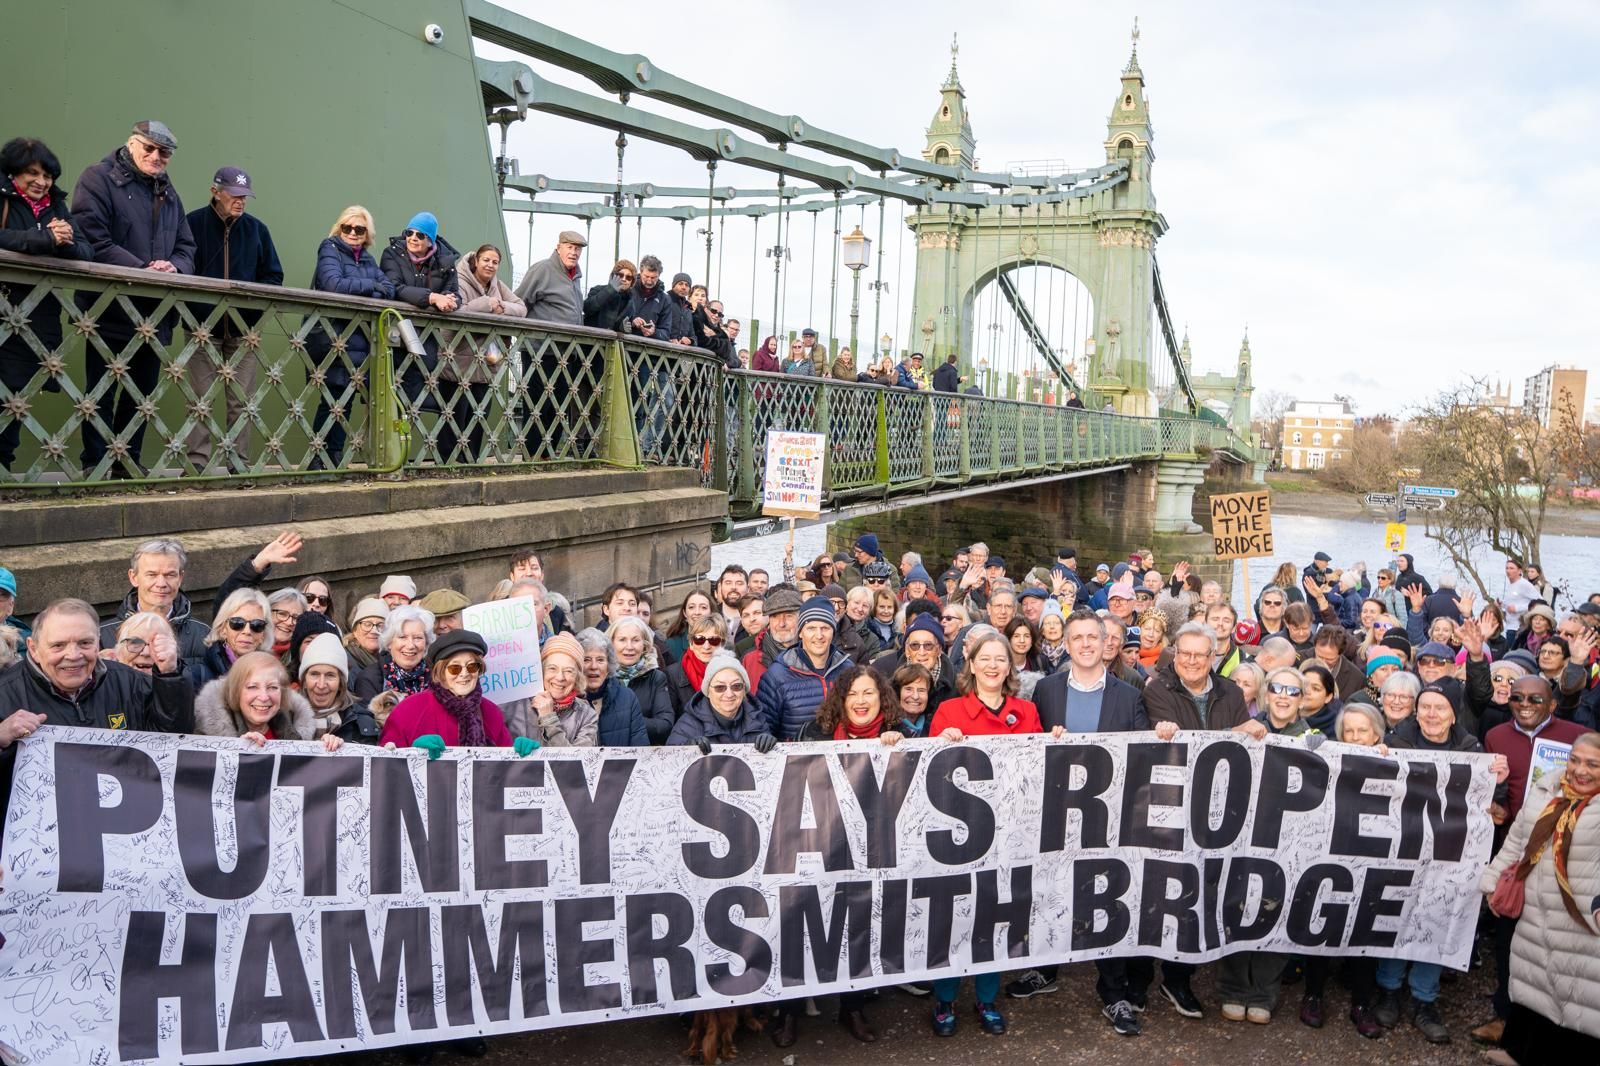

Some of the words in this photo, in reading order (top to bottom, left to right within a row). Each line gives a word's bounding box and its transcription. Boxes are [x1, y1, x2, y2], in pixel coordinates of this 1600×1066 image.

[779, 457, 812, 468] BREXIT
[1213, 496, 1268, 517] MOVE
[1218, 514, 1263, 534] THE
[1214, 533, 1273, 556] BRIDGE
[466, 601, 532, 633] BARNES
[480, 665, 537, 694] BRIDGE
[54, 743, 637, 900] PUTNEY
[681, 746, 996, 880] SAYS
[1039, 741, 1472, 862] REOPEN
[117, 864, 1032, 1062] HAMMERSMITH
[1071, 857, 1415, 953] BRIDGE
